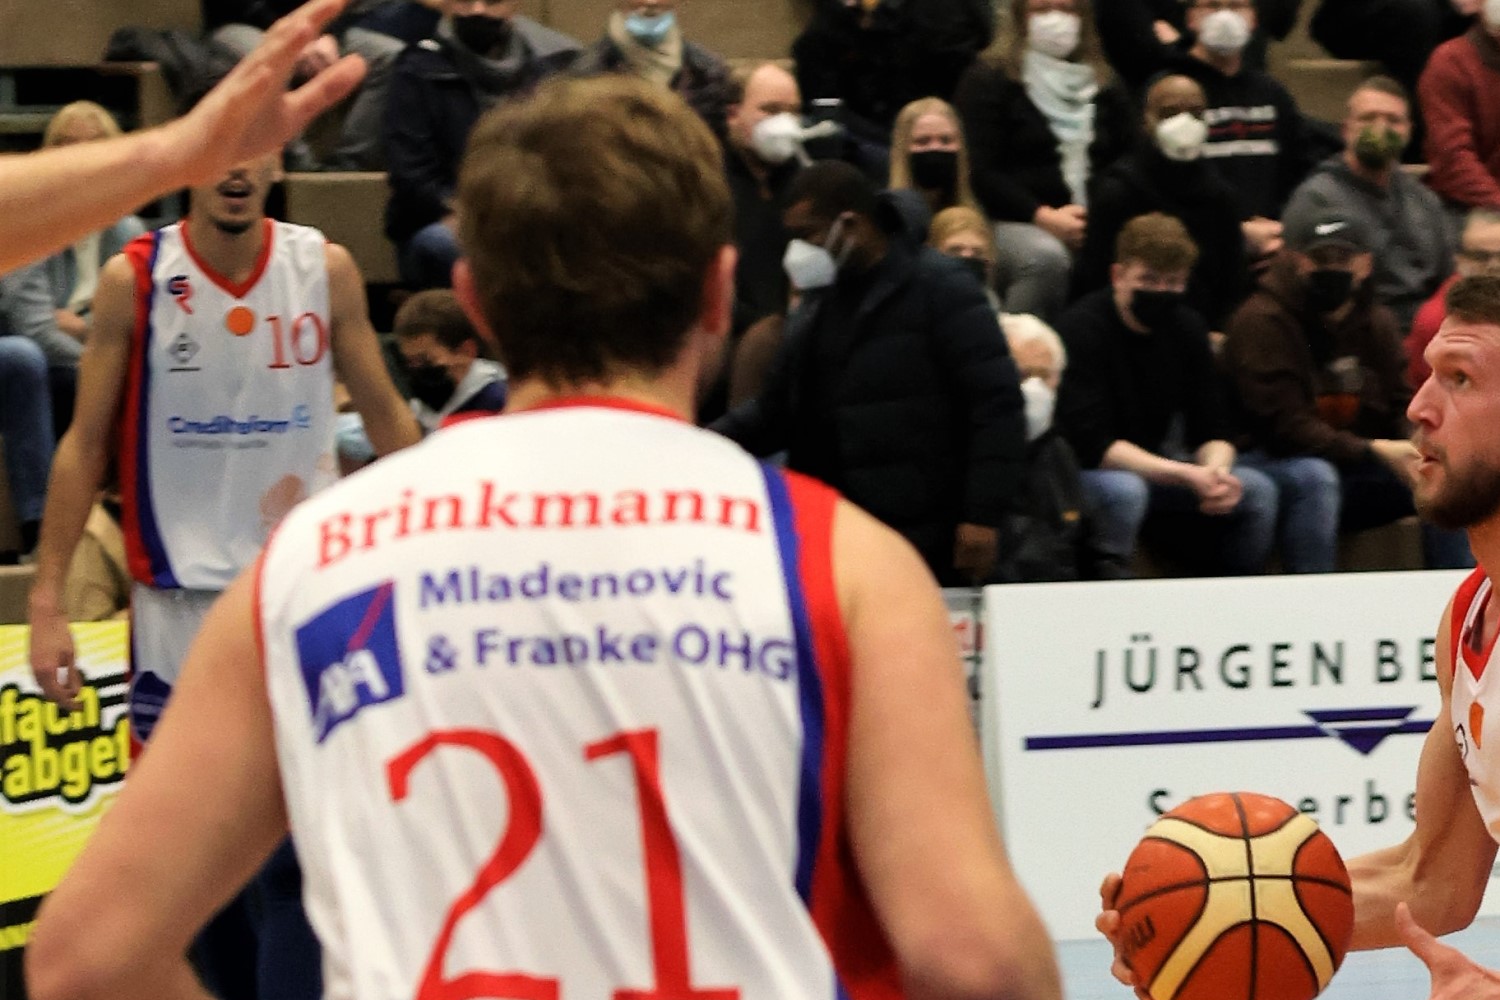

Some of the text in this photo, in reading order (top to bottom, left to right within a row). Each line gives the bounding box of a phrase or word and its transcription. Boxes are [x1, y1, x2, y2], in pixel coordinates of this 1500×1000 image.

[266, 312, 330, 369] 10
[315, 481, 765, 569] Brinkmann
[418, 559, 734, 607] Mladenovic
[424, 634, 459, 676] &
[671, 623, 798, 683] OHG
[1090, 632, 1345, 710] JÜRGEN
